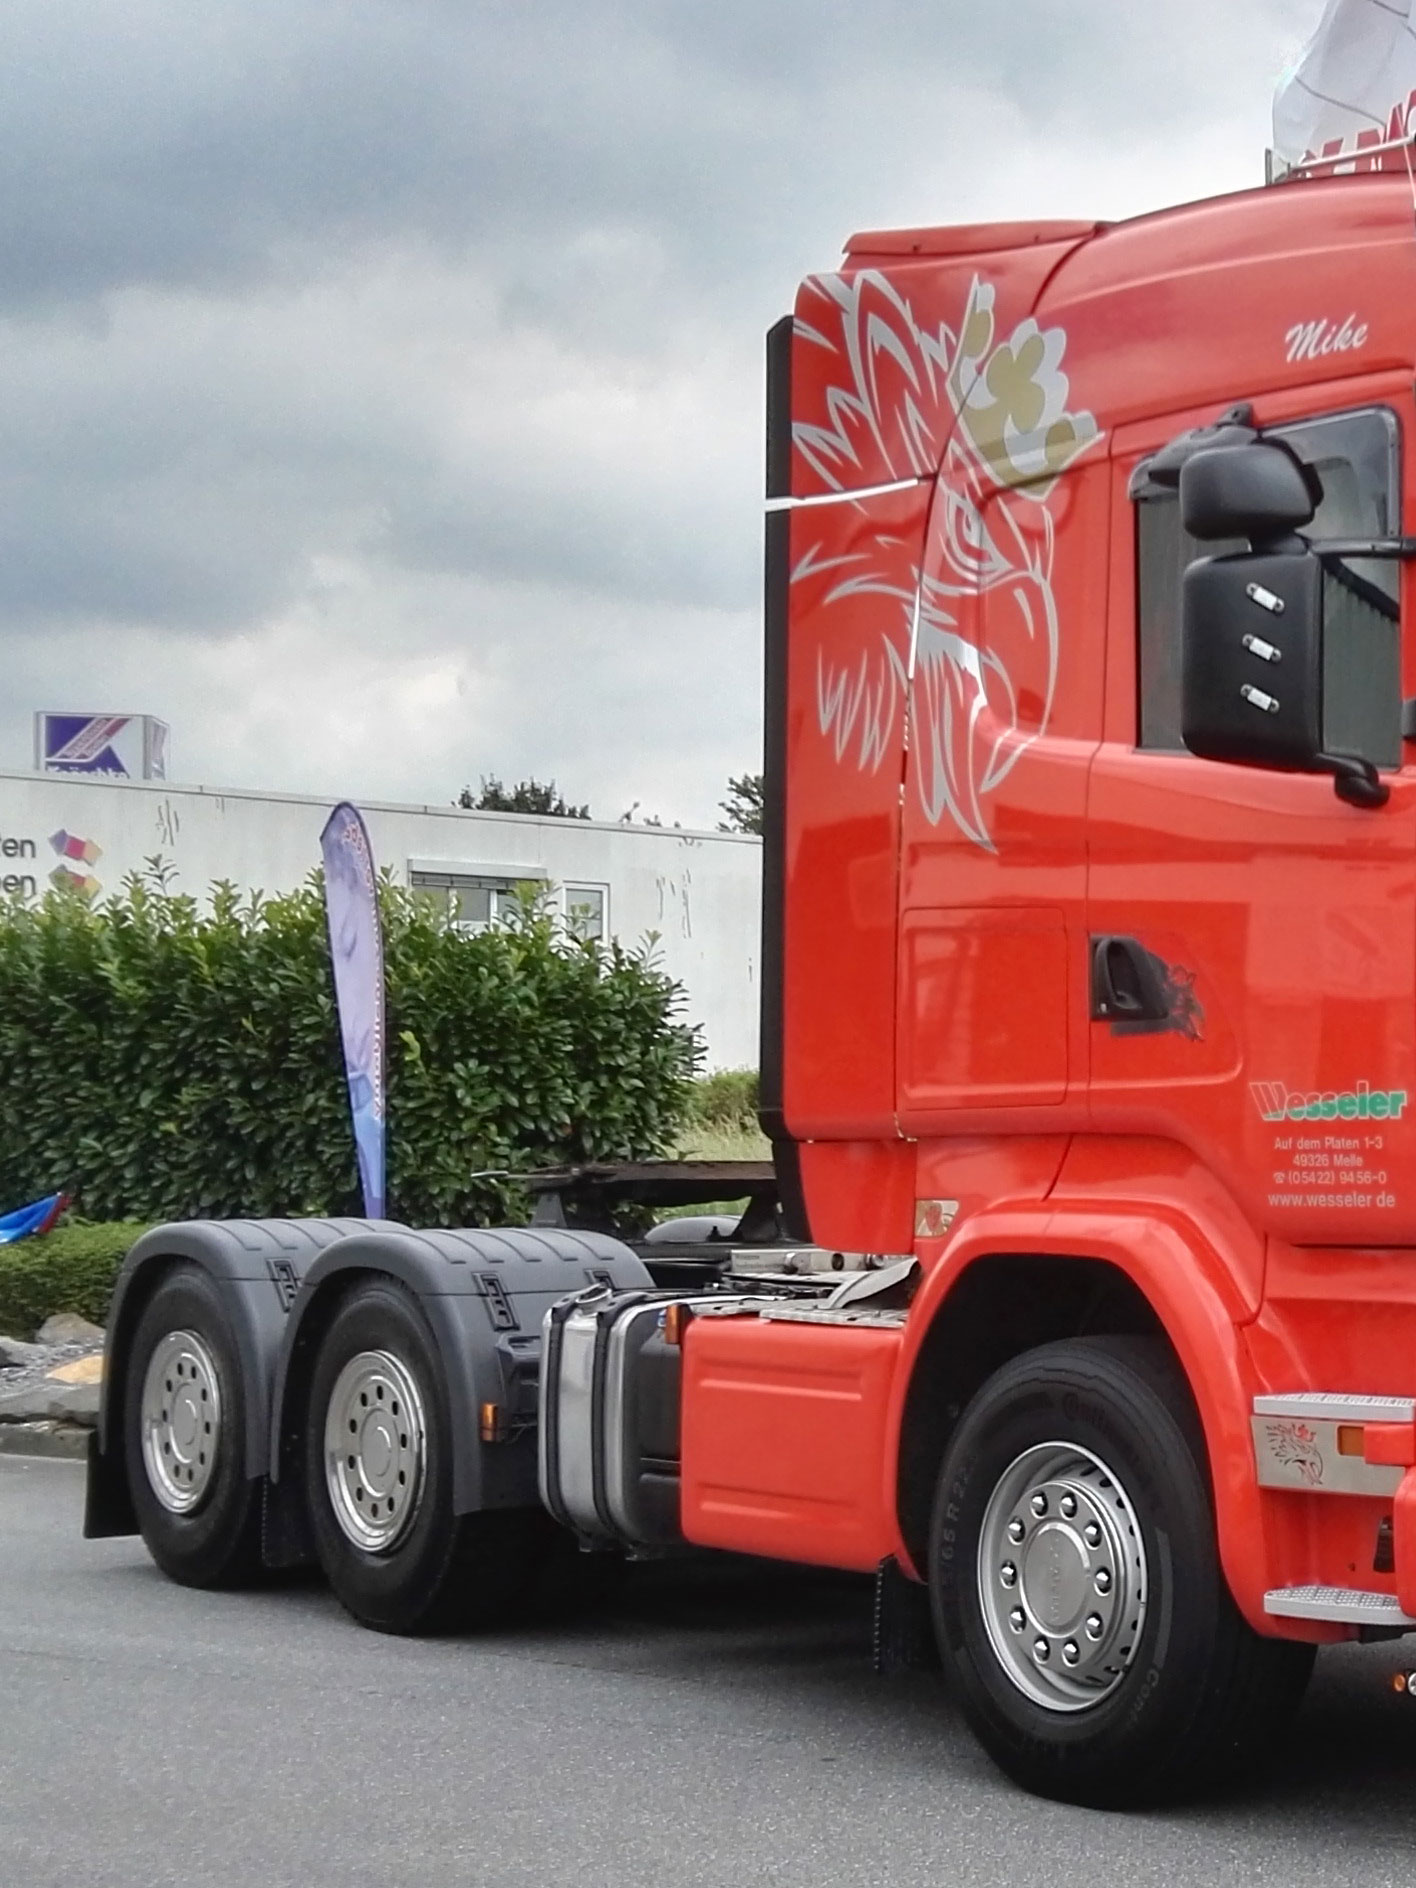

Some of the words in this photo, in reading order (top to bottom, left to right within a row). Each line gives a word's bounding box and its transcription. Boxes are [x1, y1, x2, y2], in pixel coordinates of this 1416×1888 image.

[1284, 312, 1368, 363] Mike
[0, 837, 36, 858] en
[0, 874, 36, 896] en
[1249, 1080, 1407, 1121] Wesseler
[1274, 1137, 1293, 1149] Auf
[1297, 1137, 1321, 1149] dem
[1325, 1137, 1359, 1149] Platen
[1364, 1136, 1383, 1149] 1-3
[1293, 1154, 1329, 1167] 49326
[1333, 1154, 1363, 1167] Melle
[1268, 1191, 1395, 1208] www.wesselerde
